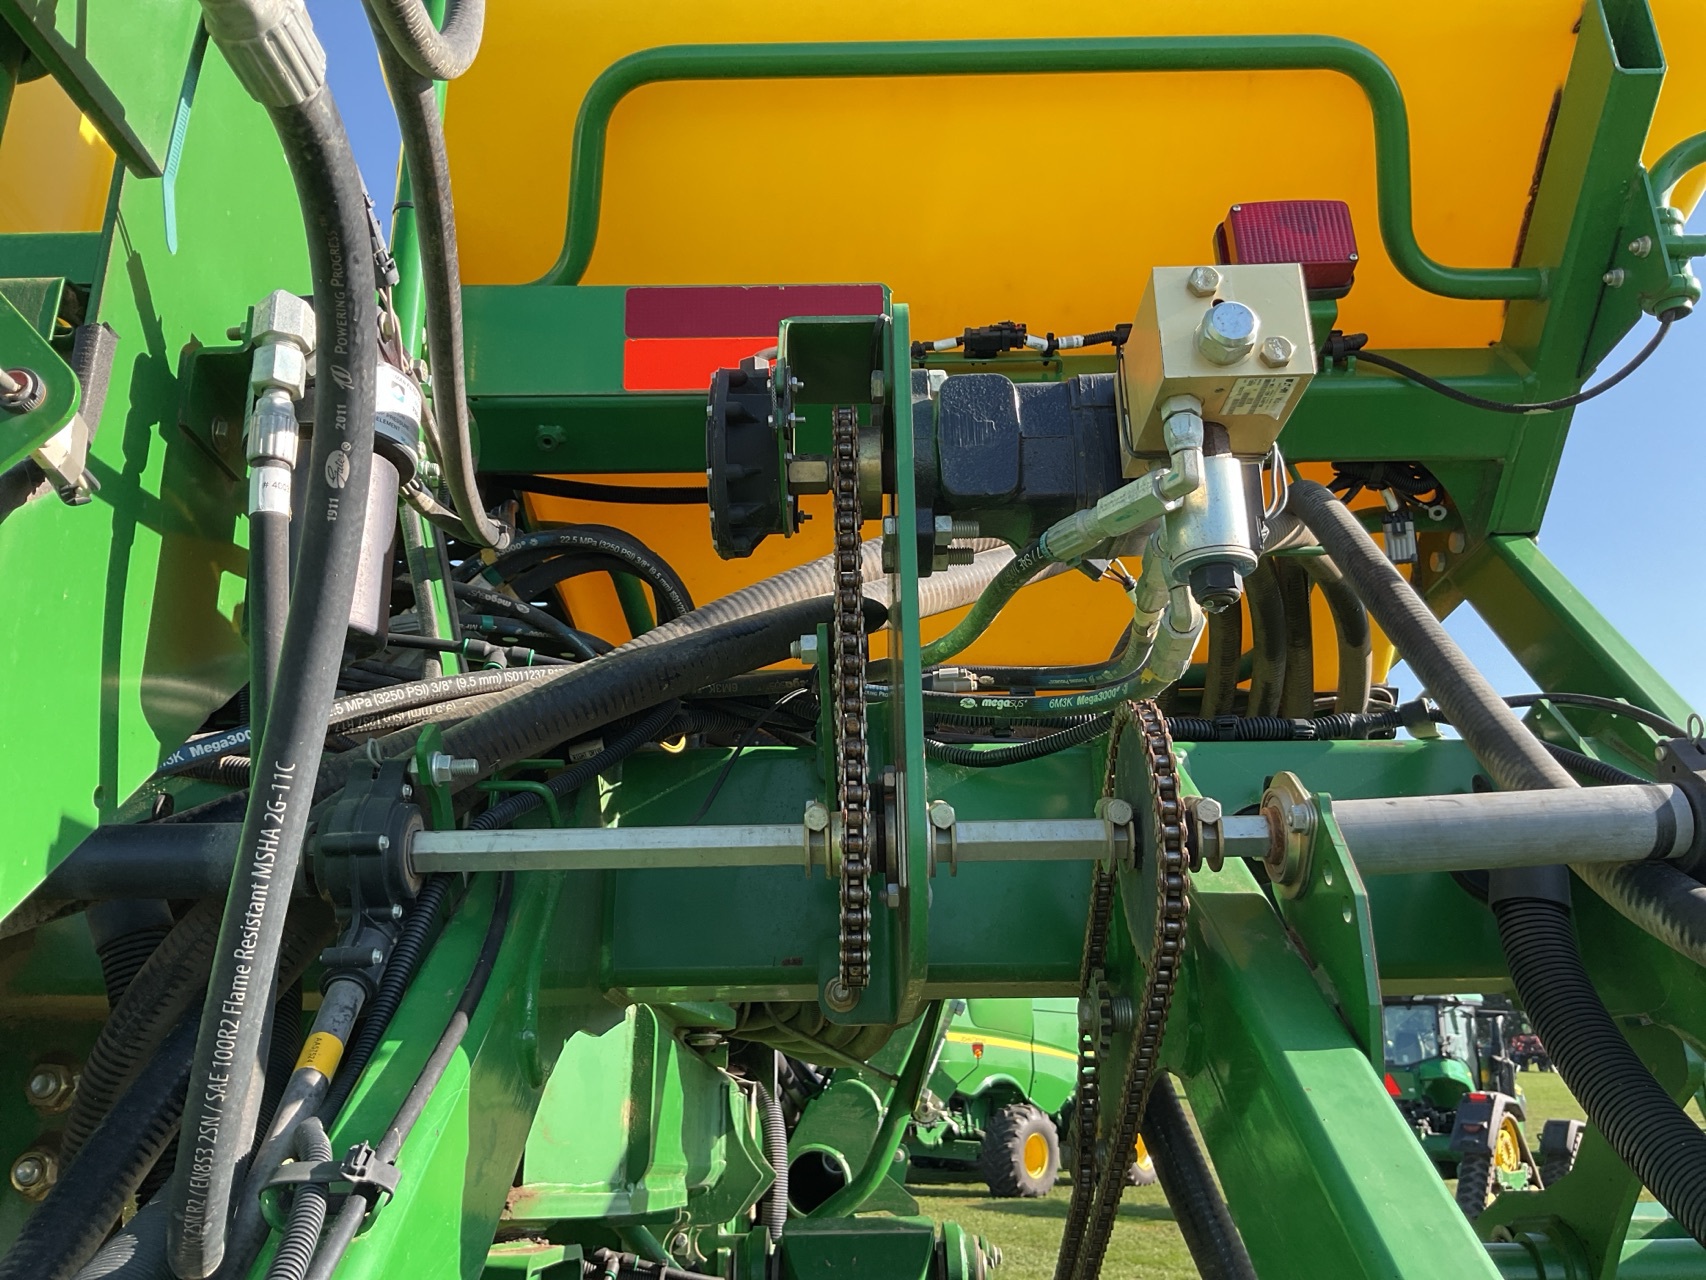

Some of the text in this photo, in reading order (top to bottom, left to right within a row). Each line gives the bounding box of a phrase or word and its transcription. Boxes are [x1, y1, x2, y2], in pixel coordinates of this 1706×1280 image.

[334, 291, 348, 355] POWERING
[335, 404, 347, 431] 2011
[325, 450, 351, 489] Gates
[326, 497, 339, 522] 1911
[560, 535, 578, 544] 22.5
[579, 536, 598, 547] MPa
[599, 539, 620, 553] (3250
[620, 547, 636, 561] PSI)
[1017, 553, 1033, 571] SAE
[345, 697, 373, 712] MPa
[373, 690, 405, 706] (3250
[406, 683, 430, 698] PSI)
[430, 679, 453, 693] 3/8"
[456, 676, 477, 691] (9.5
[478, 672, 502, 686] mm)
[981, 698, 1025, 710] megasys
[1048, 697, 1074, 709] 6M3K
[1076, 689, 1118, 706] Mega3000
[264, 760, 296, 825] 2G-11C
[251, 828, 282, 879] MSHA
[234, 883, 269, 960] Resistant
[222, 963, 252, 1015] Flame
[212, 1018, 240, 1067] 100R2
[205, 1071, 229, 1102] SAE
[198, 1115, 221, 1144] 2SN
[189, 1148, 214, 1188] EN853
[186, 1198, 206, 1214] R2
